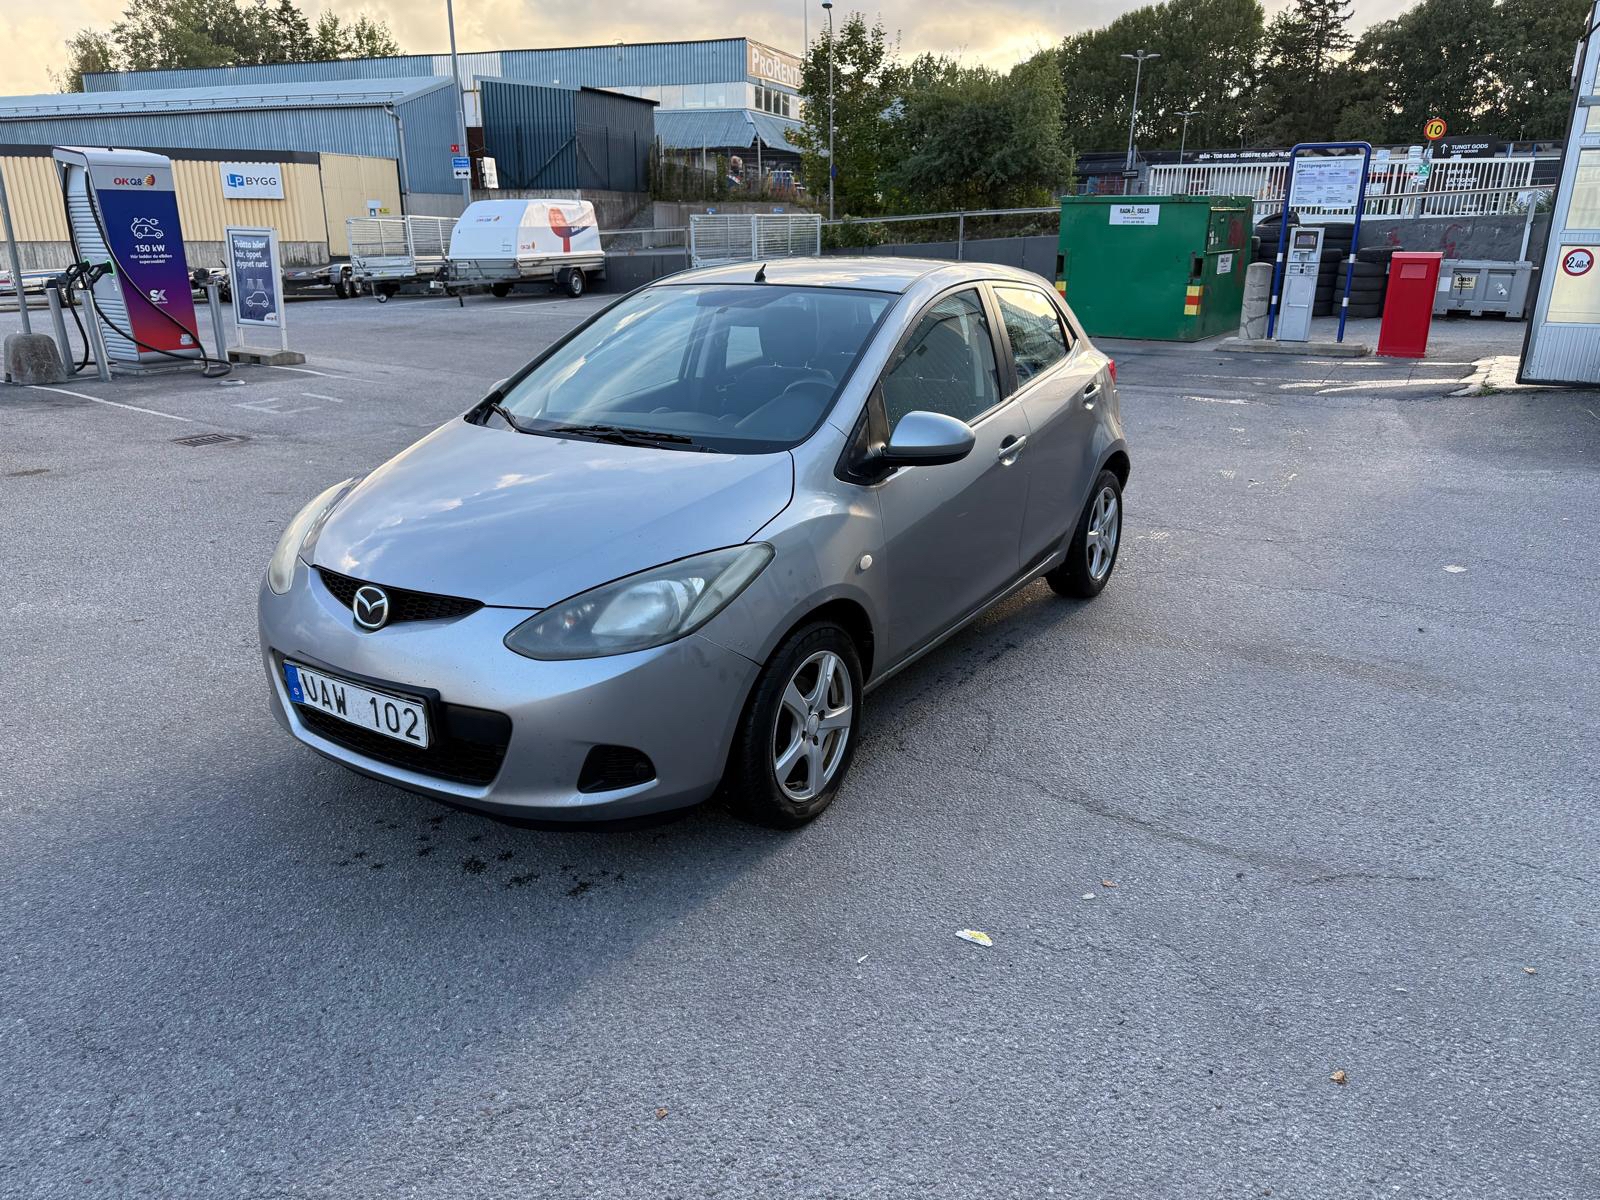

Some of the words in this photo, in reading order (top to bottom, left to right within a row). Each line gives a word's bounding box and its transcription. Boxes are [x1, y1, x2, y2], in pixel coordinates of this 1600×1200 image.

[1429, 124, 1442, 135] 10
[245, 176, 277, 186] BYGG
[135, 244, 150, 252] 150
[152, 244, 165, 252] kW
[234, 240, 251, 249] Tvätta
[252, 241, 265, 249] bilen
[235, 250, 246, 259] här,
[236, 260, 255, 270] dygnet
[149, 289, 168, 301] SK
[301, 673, 347, 716] UAW
[369, 696, 421, 742] 102
